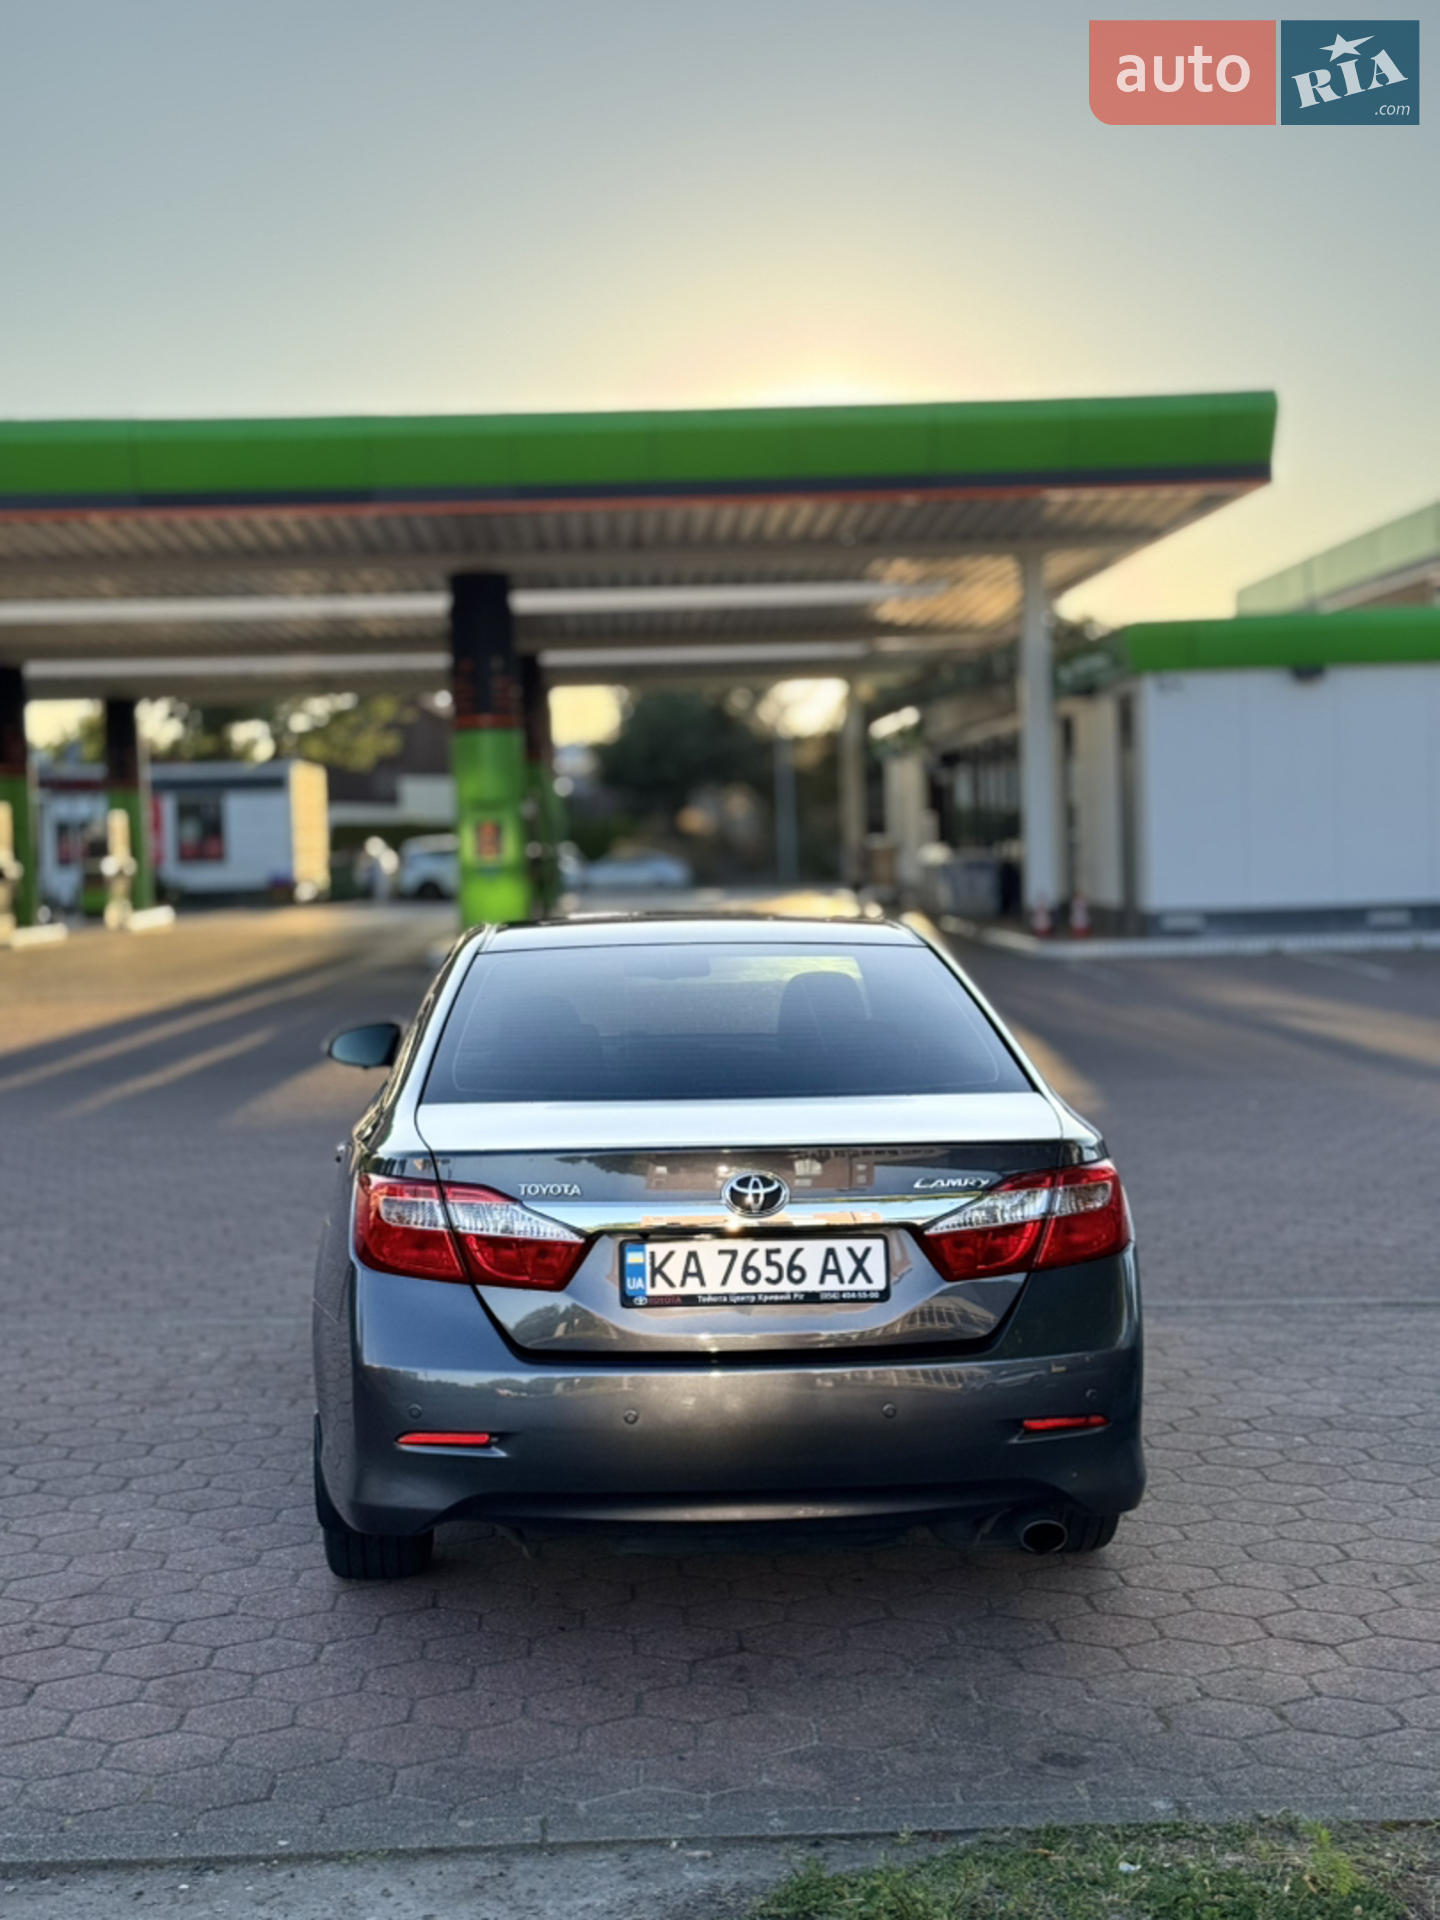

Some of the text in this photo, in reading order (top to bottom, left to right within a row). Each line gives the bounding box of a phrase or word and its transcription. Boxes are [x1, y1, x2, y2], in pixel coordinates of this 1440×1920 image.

[518, 1183, 582, 1196] TOYOTA
[913, 1177, 991, 1189] CAMRY
[649, 1246, 874, 1288] KA 7656 AX
[627, 1276, 645, 1290] UA
